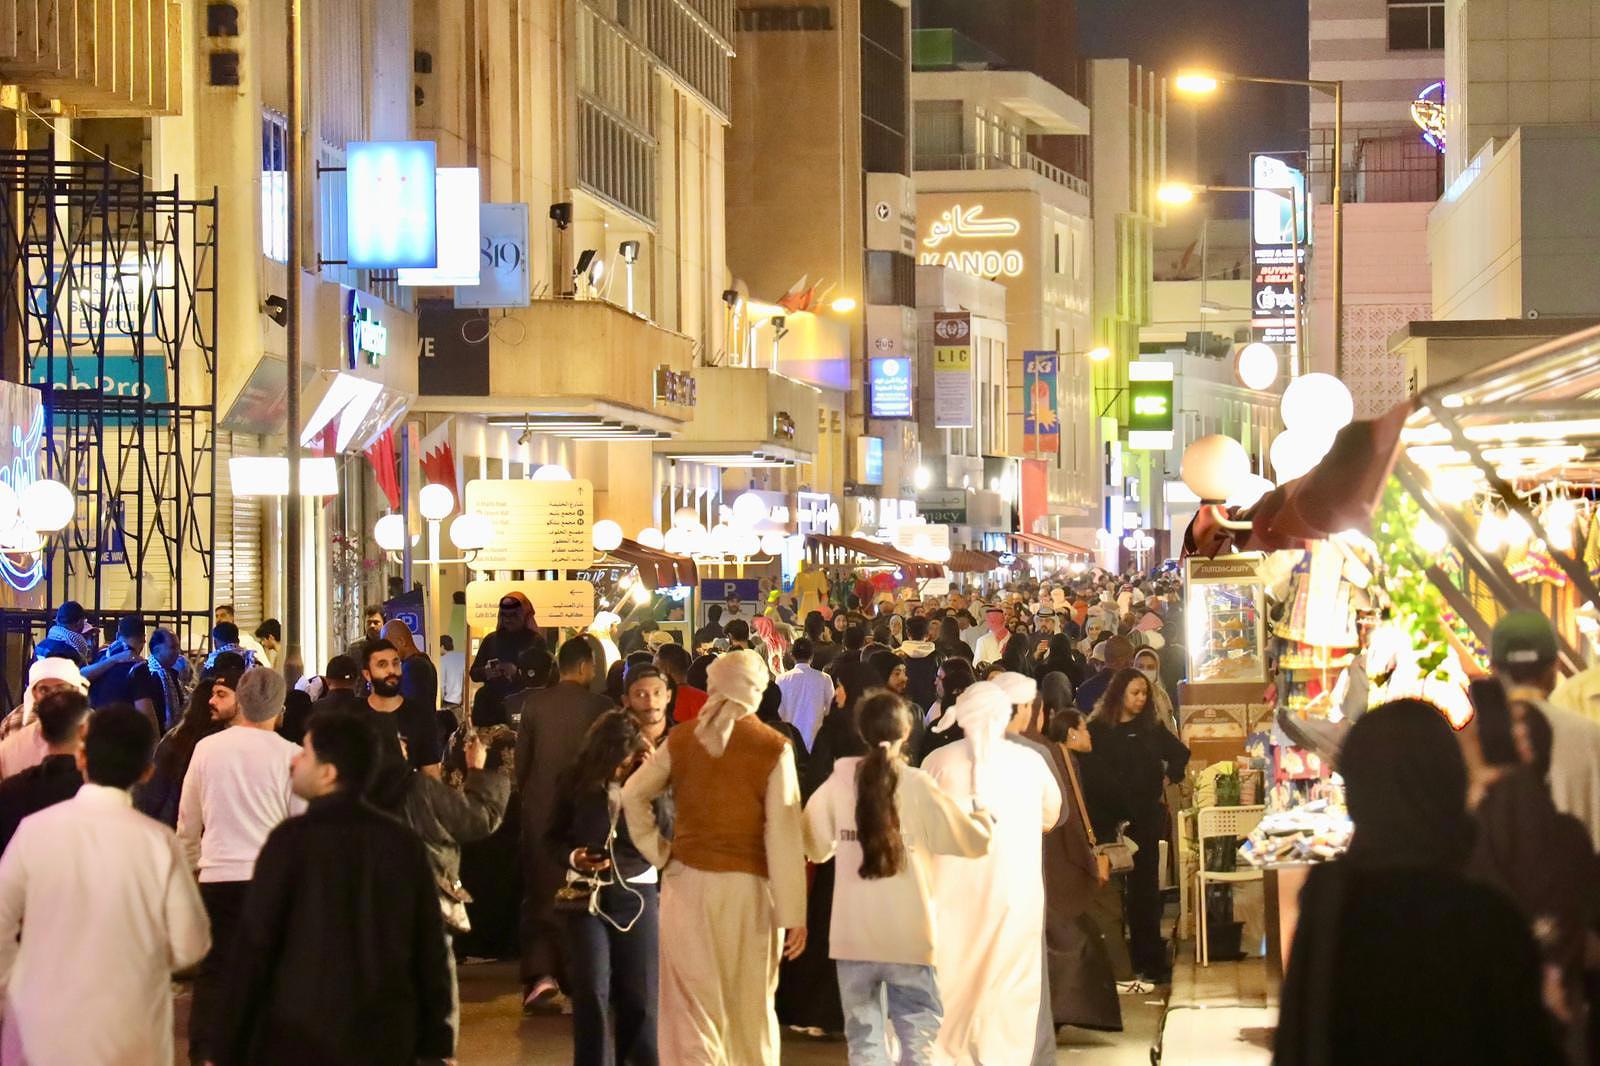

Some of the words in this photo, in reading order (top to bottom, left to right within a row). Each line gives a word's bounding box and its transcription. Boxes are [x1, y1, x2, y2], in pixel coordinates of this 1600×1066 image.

[922, 204, 1020, 247] كانو
[920, 249, 1024, 277] KANOO
[1264, 274, 1304, 283] SELLIG
[80, 318, 135, 331] Buding
[39, 375, 151, 400] bPro
[724, 582, 737, 597] P
